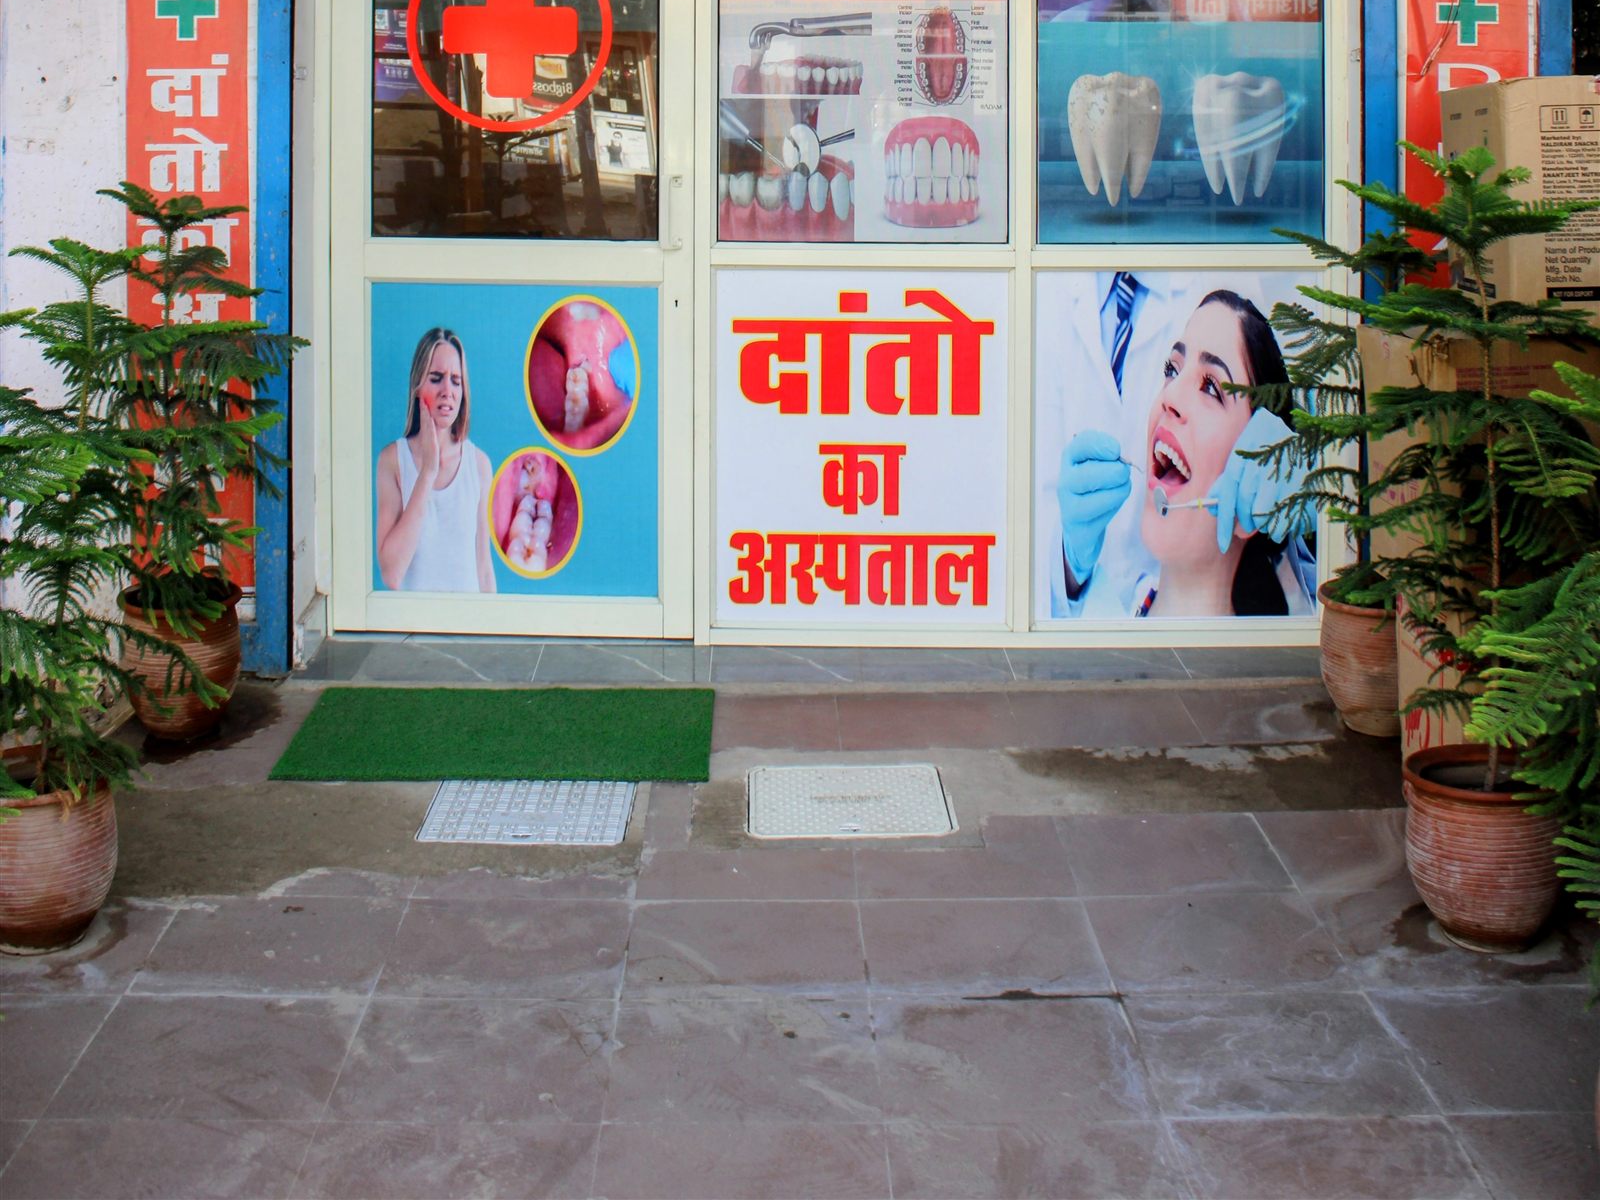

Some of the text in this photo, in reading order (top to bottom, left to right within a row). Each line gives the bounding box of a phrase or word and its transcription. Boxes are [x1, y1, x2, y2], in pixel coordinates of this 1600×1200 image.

[1560, 256, 1591, 265] Quantity
[732, 289, 995, 416] दांतो
[819, 443, 907, 516] का
[729, 531, 996, 606] अस्पताल
